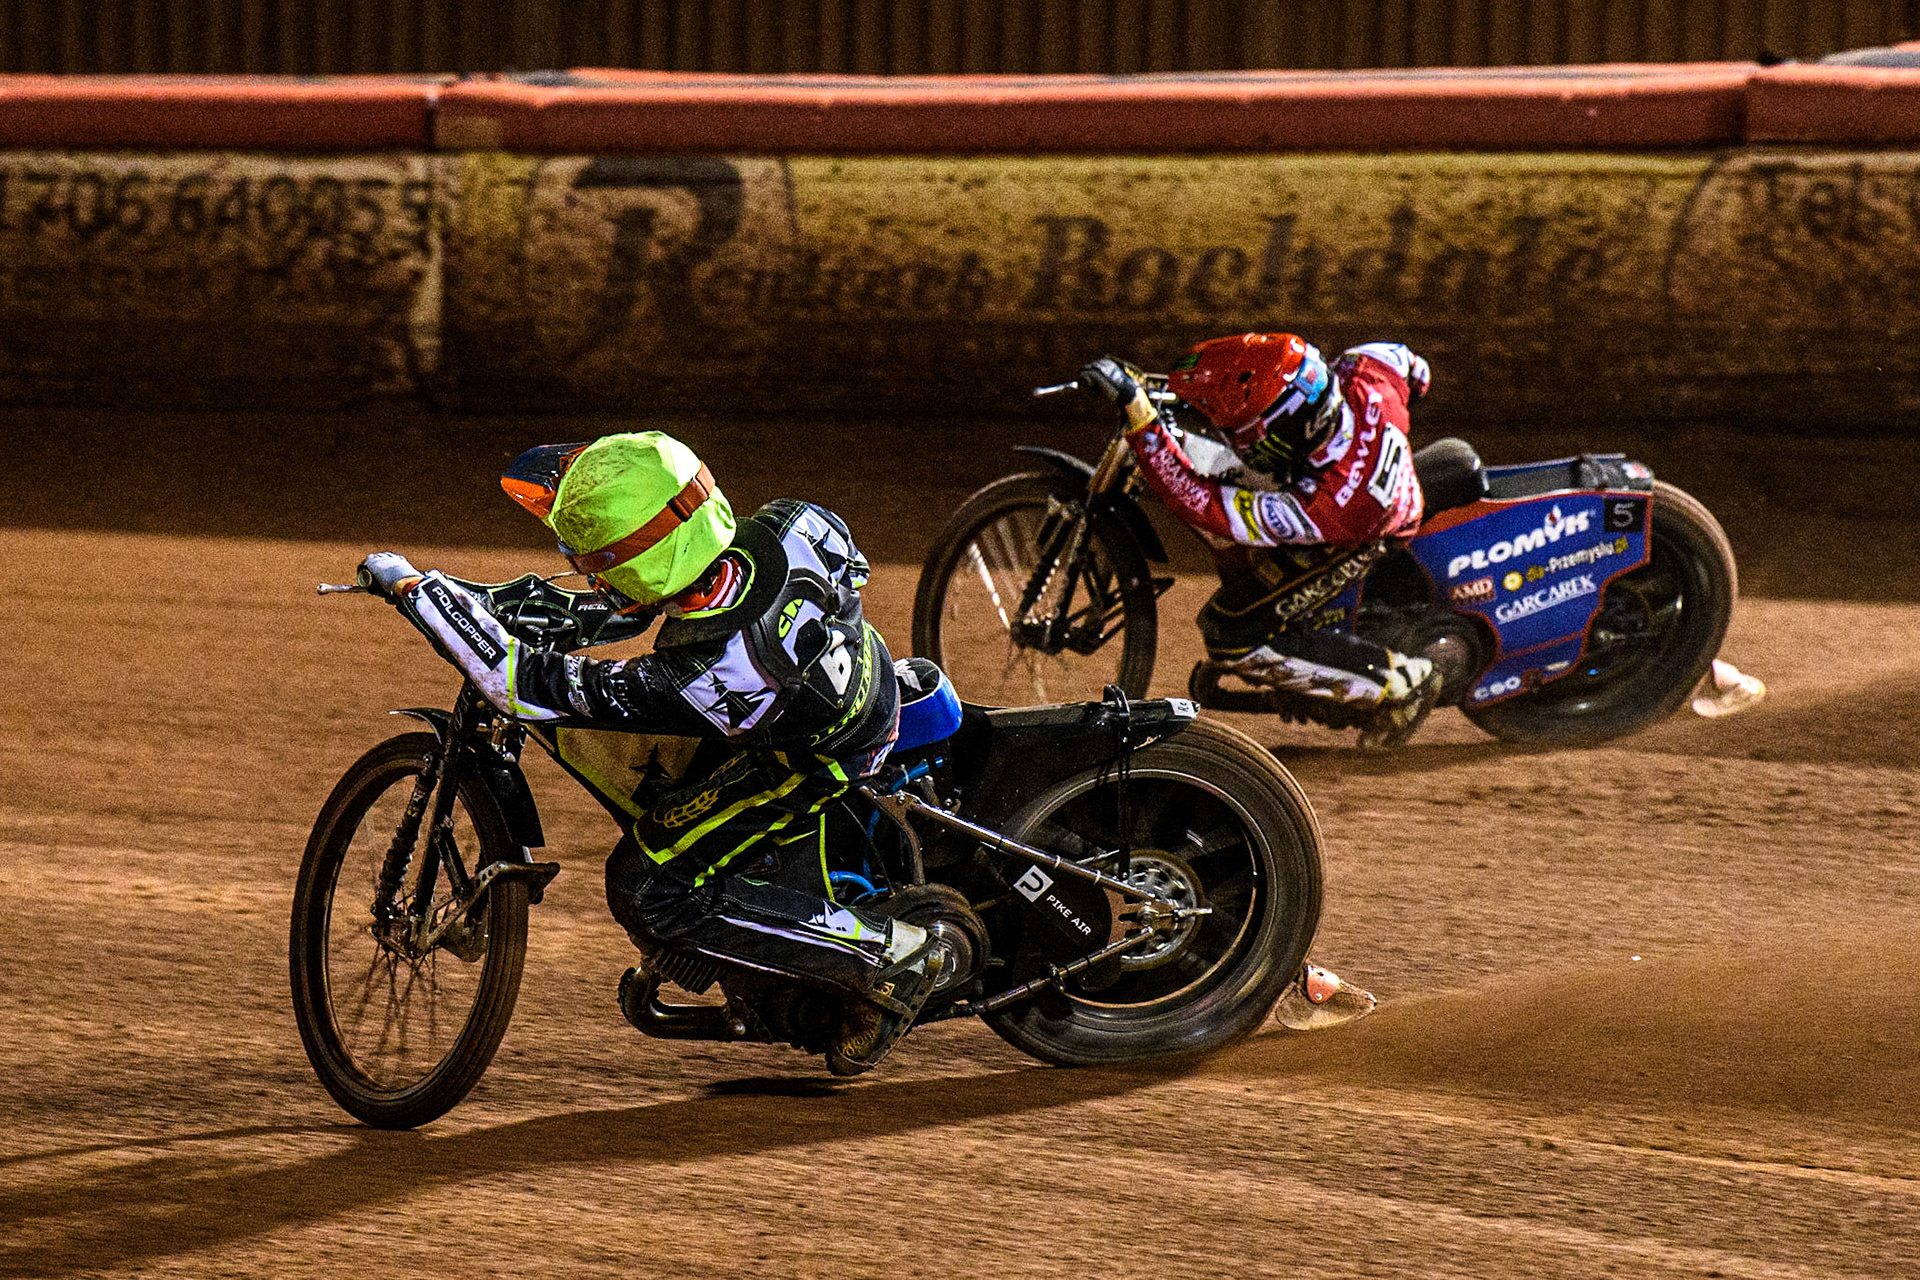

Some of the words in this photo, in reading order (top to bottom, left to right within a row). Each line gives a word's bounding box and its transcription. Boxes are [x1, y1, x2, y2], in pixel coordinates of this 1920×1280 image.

[1334, 384, 1384, 509] BEWLEY
[1612, 502, 1635, 528] 5
[1452, 578, 1493, 602] AMD
[1495, 573, 1598, 621] GARCAREK
[431, 584, 497, 660] POLCOPPER
[819, 628, 853, 696] 6
[1046, 894, 1073, 918] PIKE
[1070, 917, 1092, 936] AIR
